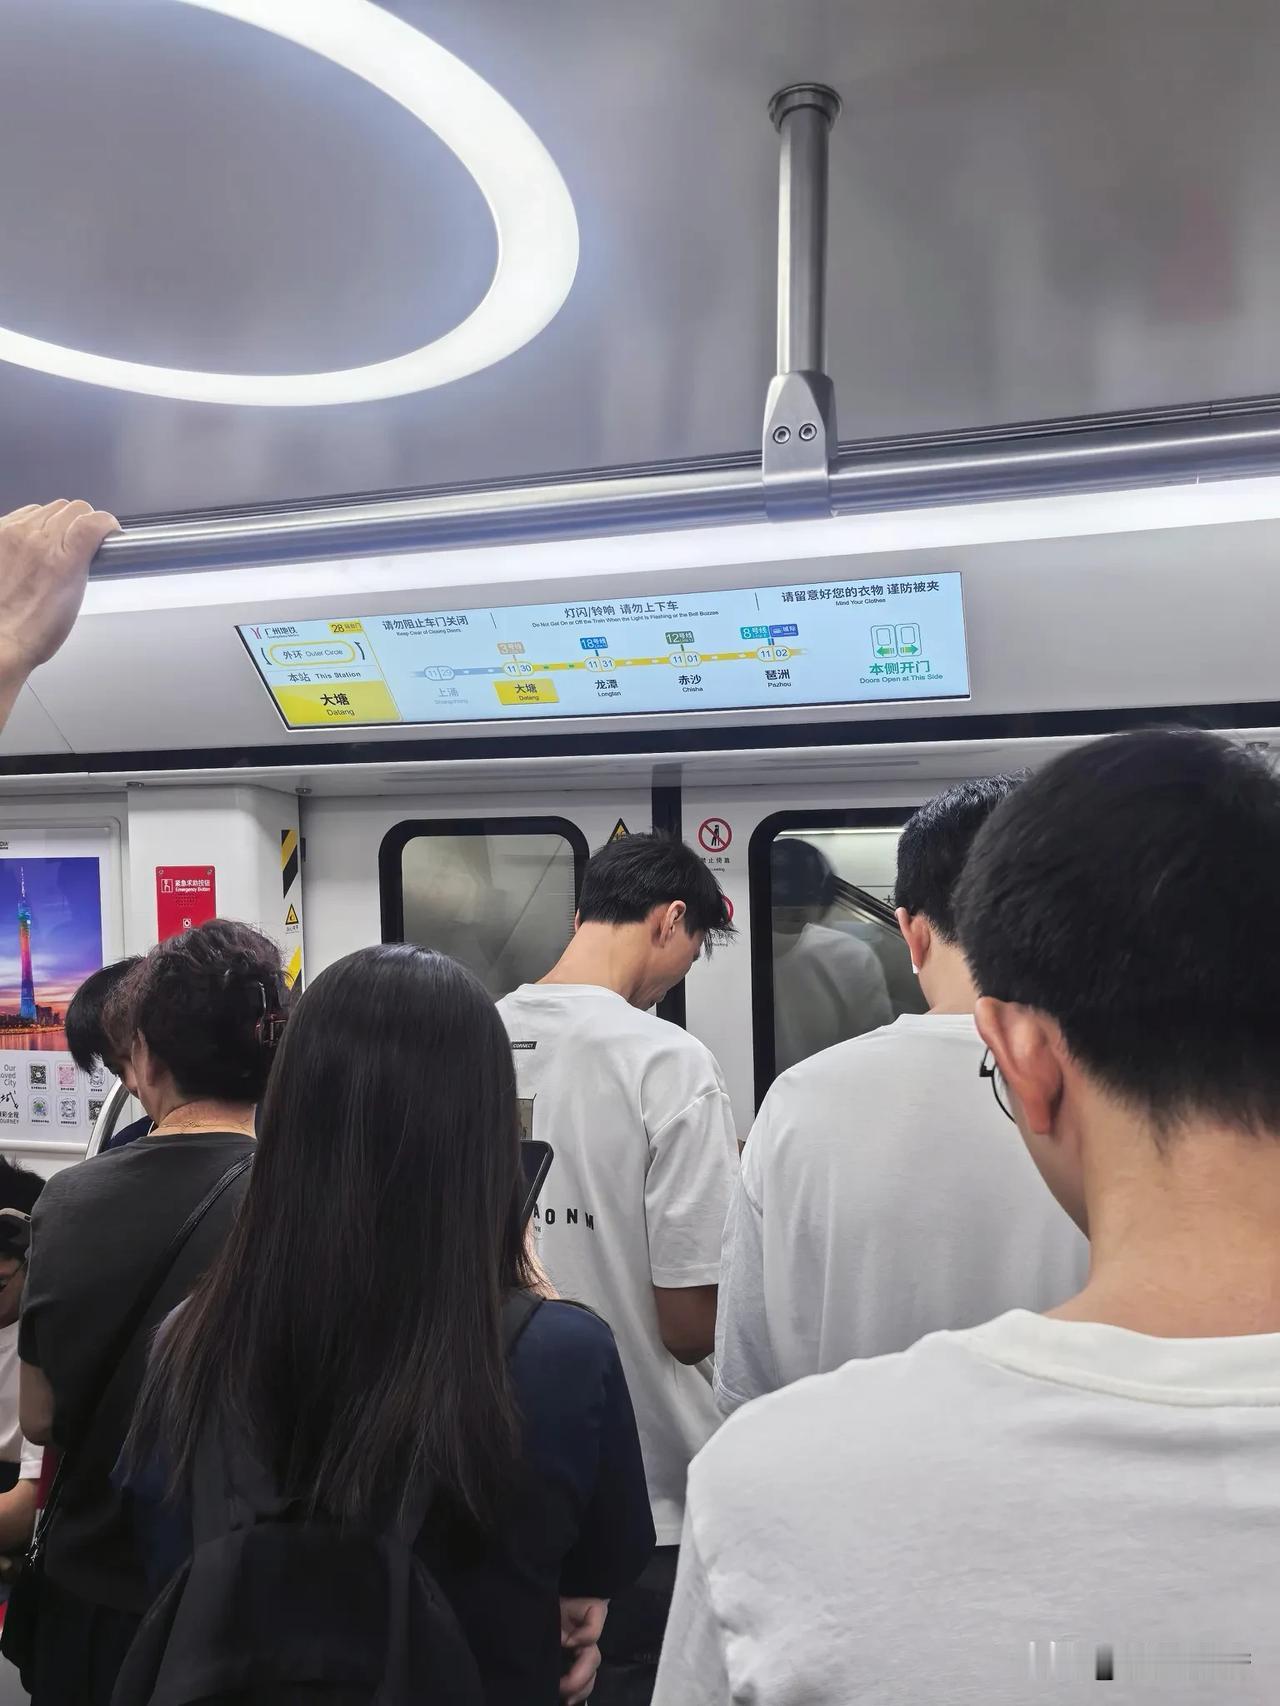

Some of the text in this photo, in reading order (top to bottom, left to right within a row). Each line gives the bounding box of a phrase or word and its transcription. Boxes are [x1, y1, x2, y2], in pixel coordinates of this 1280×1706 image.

[781, 580, 939, 602] 请留意好您的衣物 谨防被夹
[564, 600, 679, 618] 灯闪/铃响 请勿上下车
[382, 615, 469, 631] 请勿阻止车门关闭
[264, 626, 298, 636] 广州地铁
[283, 650, 303, 660] 外环
[775, 648, 788, 657] 02
[602, 660, 613, 668] 31
[686, 655, 698, 663] 01
[520, 664, 532, 672] 30
[869, 660, 931, 675] 本侧开门
[288, 672, 311, 683] 本站
[333, 671, 362, 679] Station
[678, 674, 702, 685] 赤沙
[765, 669, 790, 680] 琶洲
[514, 683, 538, 694] 大塘
[595, 679, 618, 690] 龙潭
[320, 692, 350, 706] 大塘
[326, 708, 355, 716] Datang
[4, 1079, 16, 1088] City
